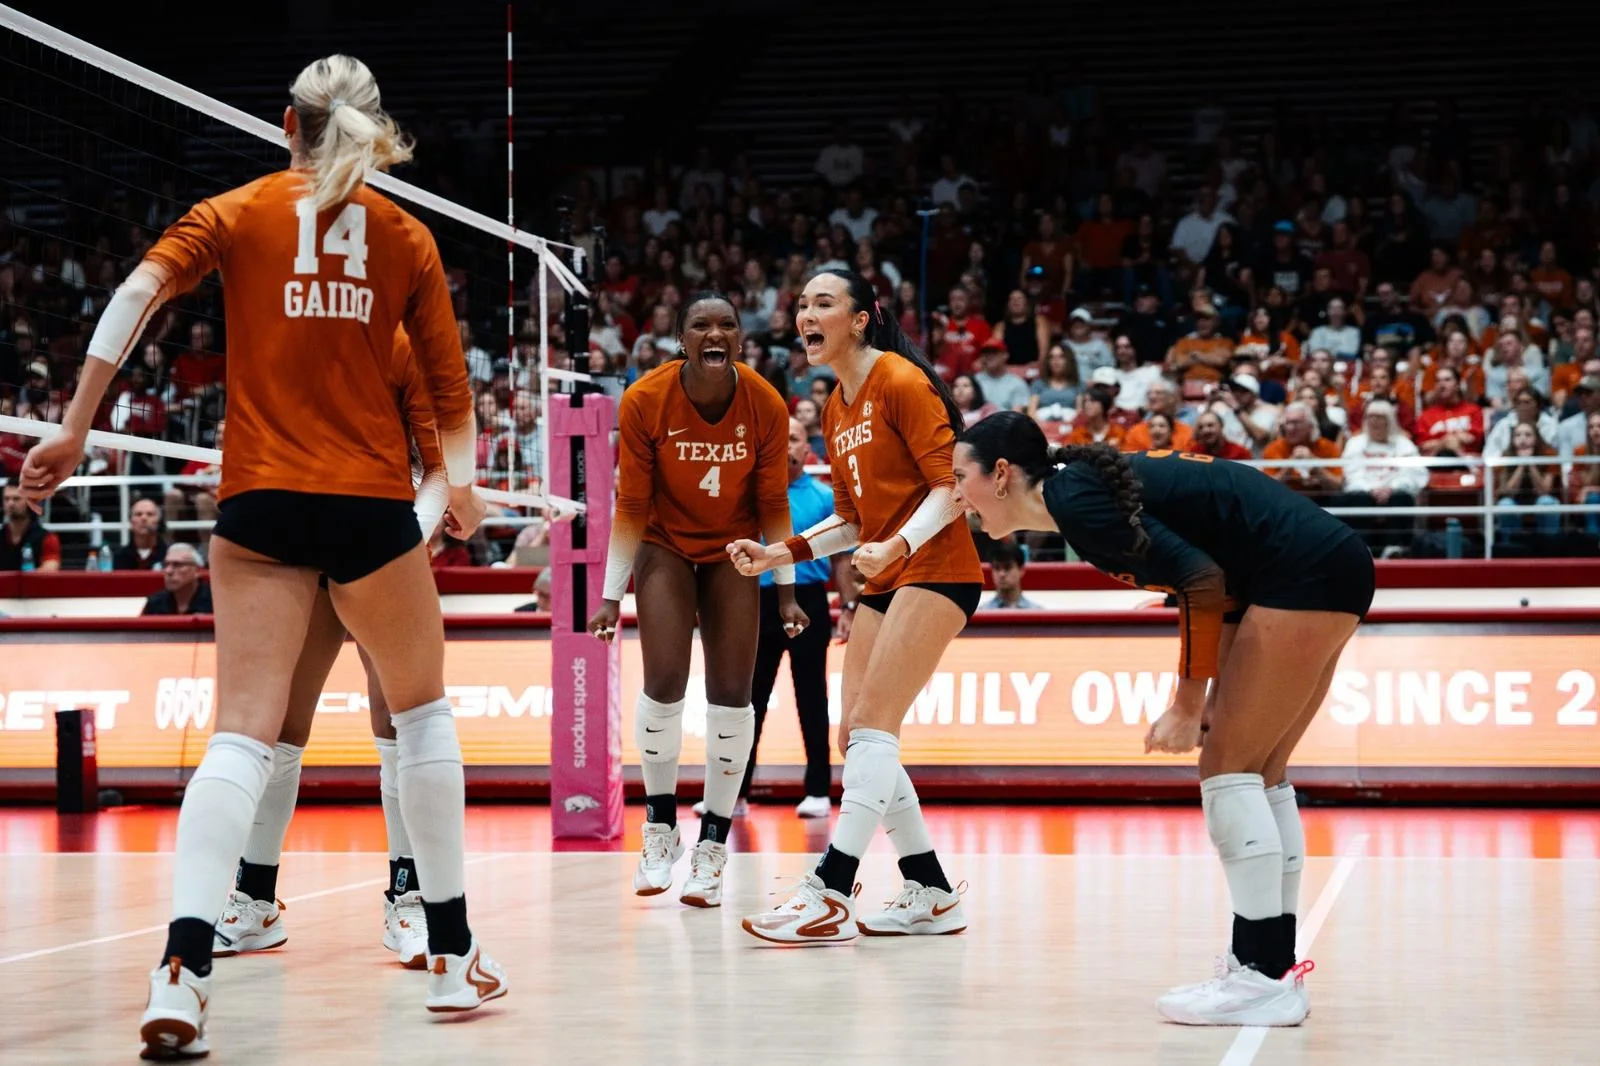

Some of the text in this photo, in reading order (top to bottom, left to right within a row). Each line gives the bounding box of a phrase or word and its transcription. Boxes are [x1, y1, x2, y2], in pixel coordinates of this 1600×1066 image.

[294, 200, 368, 280] 14
[284, 280, 374, 324] GAIDO
[675, 441, 748, 462] TEXAS
[834, 420, 873, 458] TEXAS
[698, 465, 721, 497] 4
[848, 454, 863, 498] 3
[444, 685, 554, 718] GM
[571, 657, 587, 707] sports
[1328, 669, 1533, 726] SINCE
[1555, 669, 1598, 726] 2
